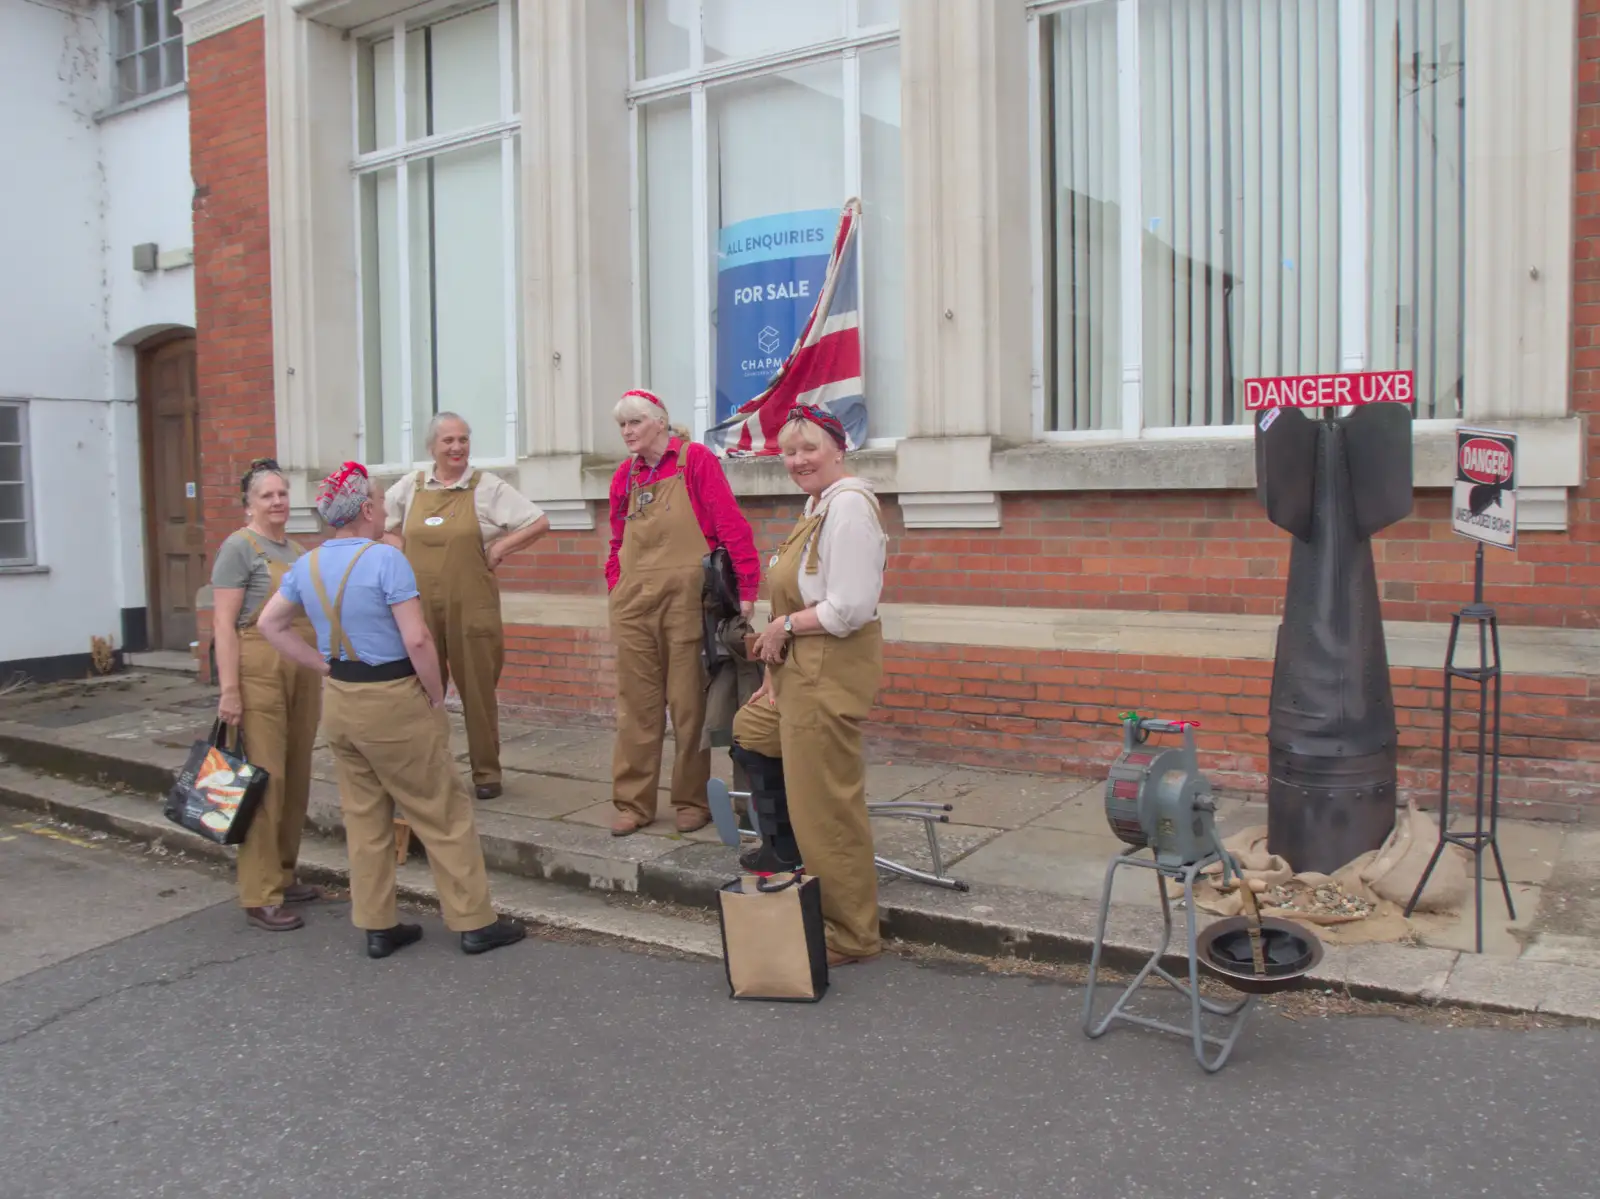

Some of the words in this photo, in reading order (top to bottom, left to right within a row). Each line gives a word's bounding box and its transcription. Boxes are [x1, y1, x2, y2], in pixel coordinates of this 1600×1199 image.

[726, 239, 744, 256] ALL
[745, 228, 824, 250] ENQUIRIES
[734, 285, 763, 305] FOR
[766, 280, 810, 300] SALE
[741, 356, 785, 371] CHAPM
[1246, 377, 1353, 407] DANGER
[1359, 374, 1411, 402] UXB
[1463, 445, 1509, 477] DANGER!
